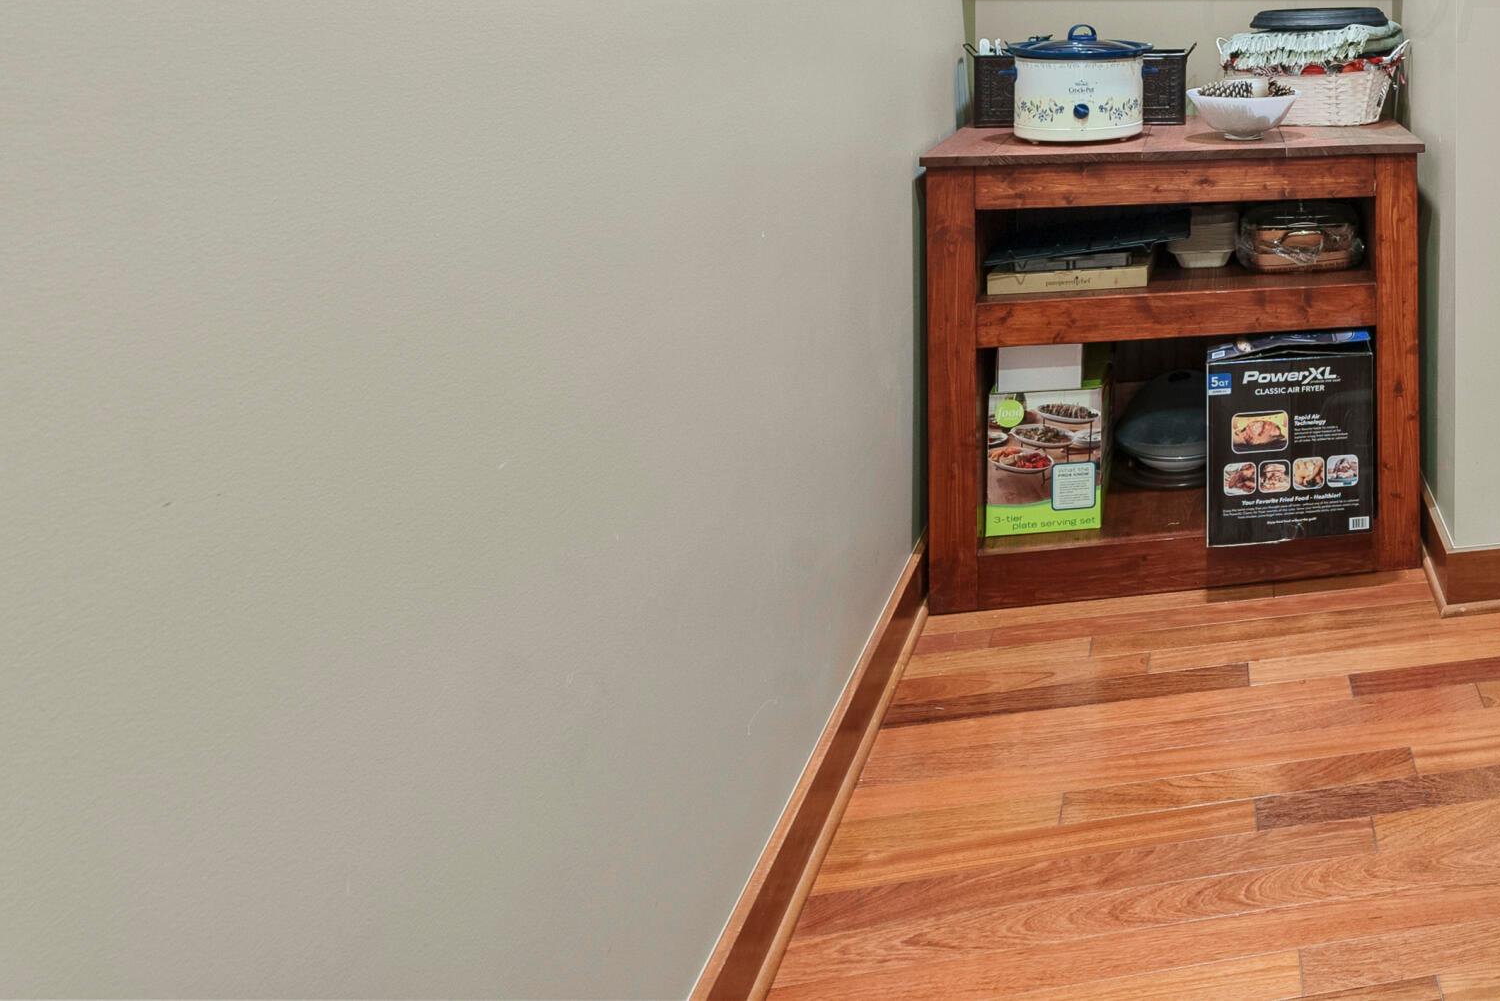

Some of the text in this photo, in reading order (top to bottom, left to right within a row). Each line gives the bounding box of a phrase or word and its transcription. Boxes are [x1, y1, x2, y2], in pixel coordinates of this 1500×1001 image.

[1068, 86, 1095, 94] Crock-Pot
[1242, 366, 1338, 385] PowerXL
[1255, 384, 1326, 396] CLASSIC AIR FRYER
[1294, 414, 1310, 422] Rapid
[1294, 419, 1327, 427] Technology
[1256, 497, 1279, 506] Favorite
[1295, 494, 1310, 502] Food
[993, 514, 1023, 524] 3-tier
[1012, 516, 1096, 530] plate serving set
